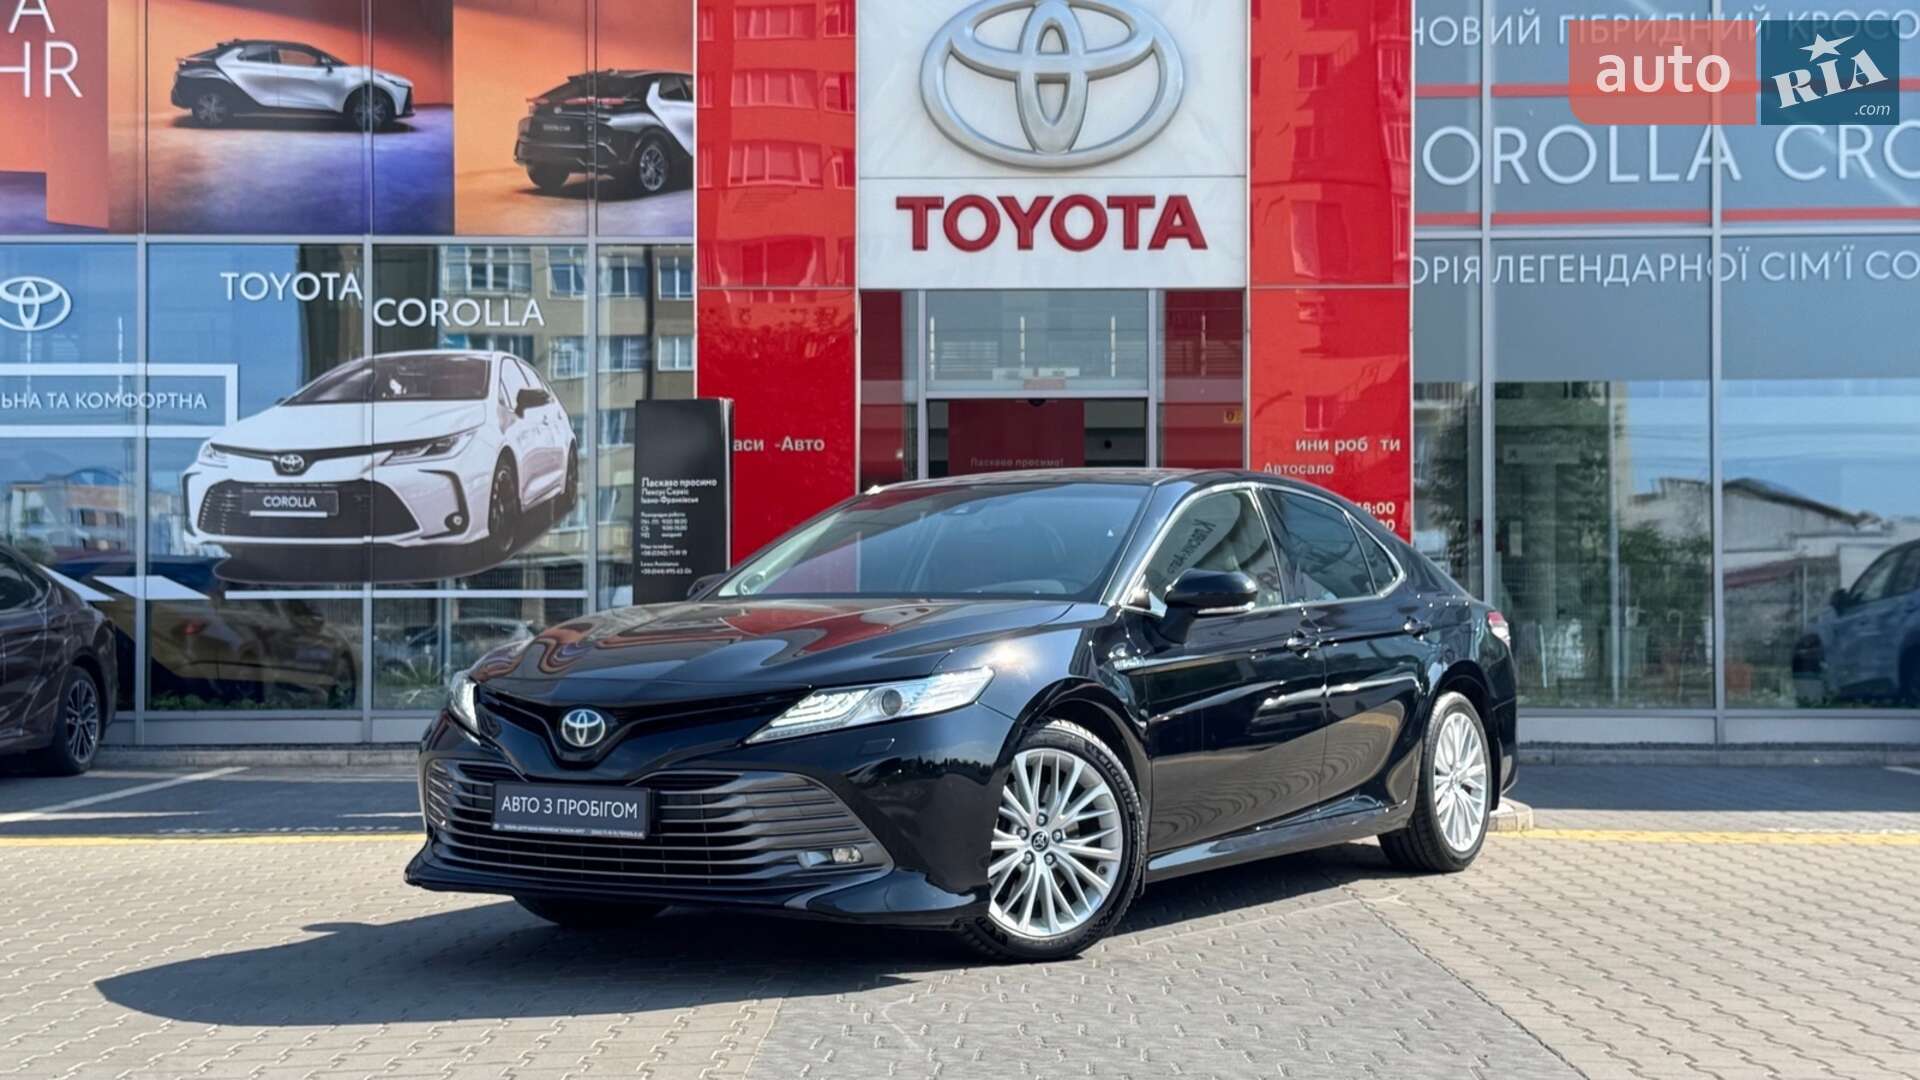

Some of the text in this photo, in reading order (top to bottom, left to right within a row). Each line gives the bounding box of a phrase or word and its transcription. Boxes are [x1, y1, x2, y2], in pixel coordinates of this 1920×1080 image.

[896, 194, 1208, 252] TOYOTA
[1492, 246, 1750, 287] ЛЕГЕНДАРНОЇ
[220, 272, 363, 301] TOYOTA
[373, 299, 545, 327] COROLLA
[47, 392, 70, 409] ТА
[76, 392, 208, 409] КОМФОРТНА
[1296, 436, 1400, 455] ини роб ти
[263, 495, 317, 508] COROLLA
[501, 796, 540, 814] АВТО
[557, 799, 638, 819] ПРОБІГОМ
